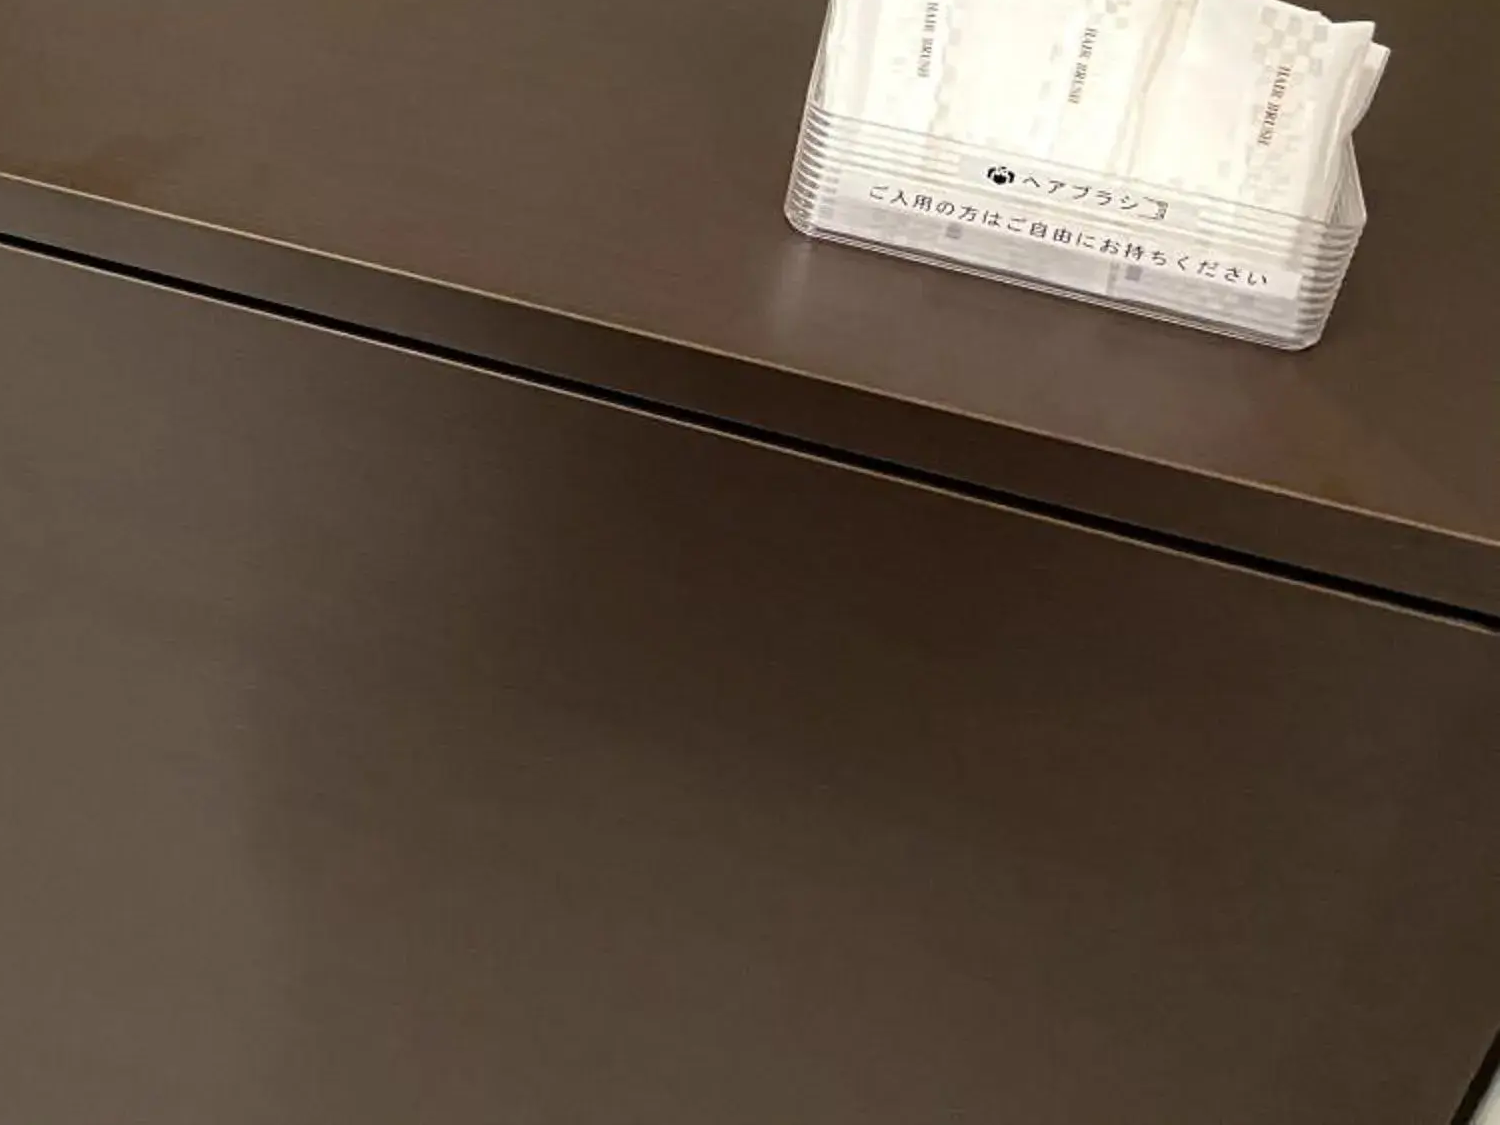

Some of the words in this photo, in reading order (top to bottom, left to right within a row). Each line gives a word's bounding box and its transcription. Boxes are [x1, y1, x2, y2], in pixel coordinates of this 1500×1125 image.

[1079, 27, 1098, 59] HAIR
[1067, 62, 1087, 104] BRUSH
[1271, 63, 1291, 99] HAIR
[1257, 101, 1280, 146] BRUSH
[1022, 174, 1140, 211] ヘアブラシ
[869, 183, 1269, 287] ご入用の方はご自由にお持ちください
